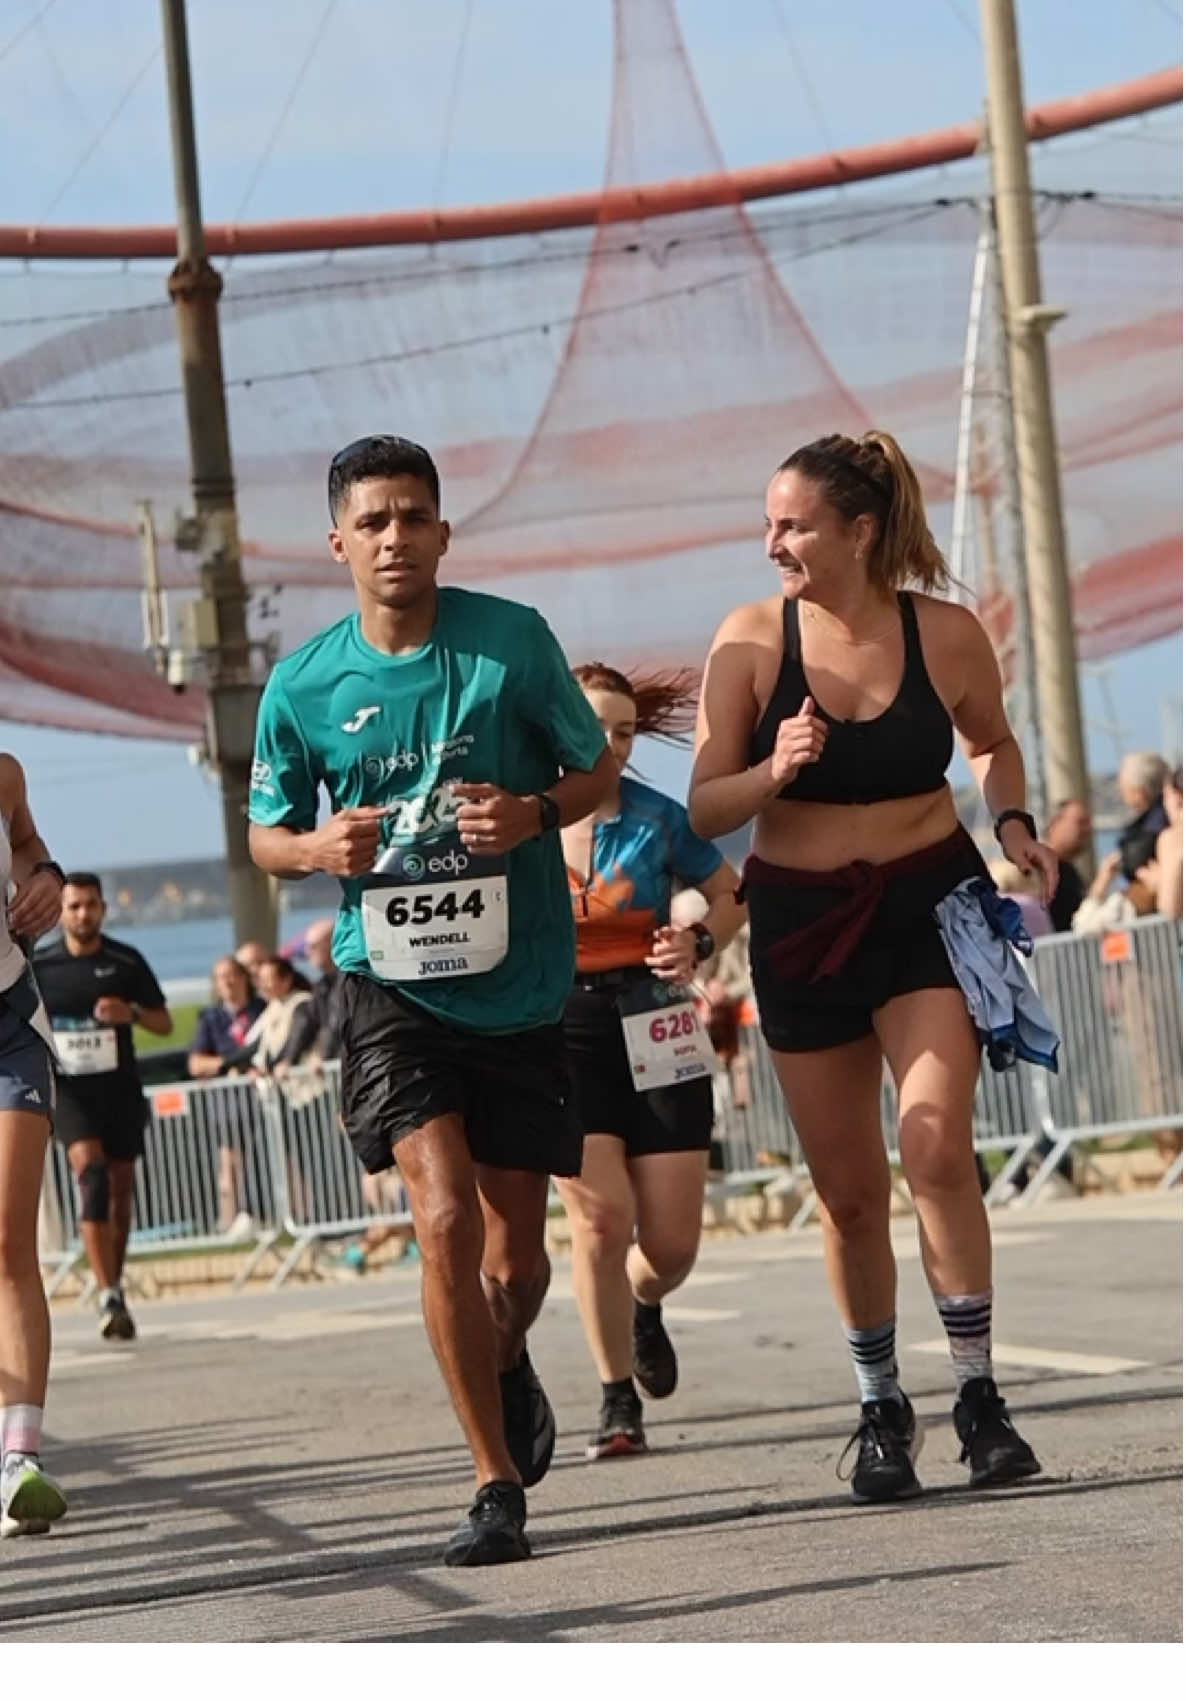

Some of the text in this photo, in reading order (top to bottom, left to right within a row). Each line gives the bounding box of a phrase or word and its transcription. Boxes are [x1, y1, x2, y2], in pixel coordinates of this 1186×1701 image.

[428, 848, 468, 876] edp
[386, 889, 485, 927] 6544
[409, 931, 471, 948] WENDELL
